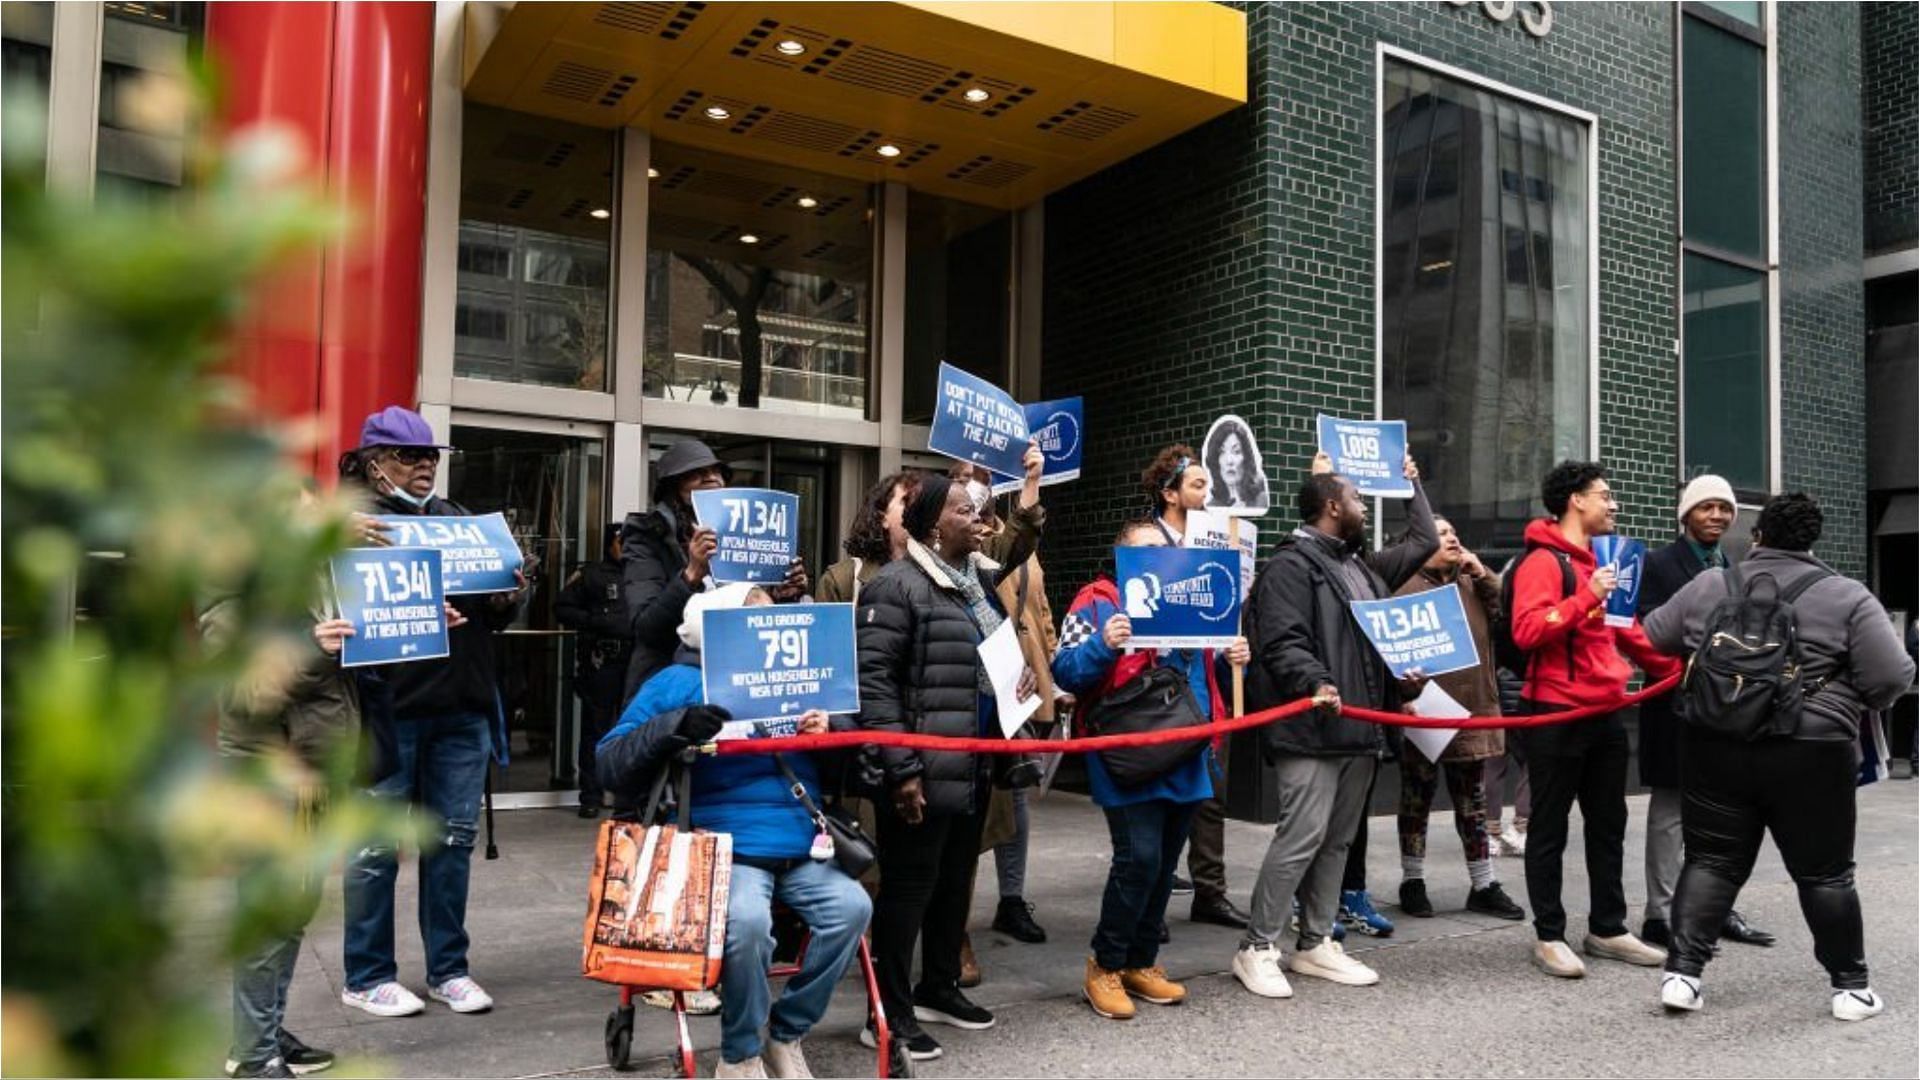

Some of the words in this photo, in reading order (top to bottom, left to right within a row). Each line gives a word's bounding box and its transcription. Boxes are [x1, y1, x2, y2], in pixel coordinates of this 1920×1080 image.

[945, 381, 975, 404] DON'T
[976, 392, 996, 413] PUT
[947, 400, 963, 418] AT
[966, 406, 986, 425] THE
[987, 414, 1013, 436] BACK
[963, 422, 984, 443] THE
[722, 498, 787, 537] 71,341
[387, 521, 488, 546] 71,341
[748, 538, 789, 552] HOUSEHOLDS
[456, 559, 503, 573] EVICTION
[720, 550, 731, 562] AT
[732, 551, 748, 563] RISK
[759, 553, 790, 566] EVICTION
[355, 560, 433, 603] 71,341
[1163, 574, 1211, 593] COMMUNITY
[1164, 592, 1188, 605] VOICES
[1190, 592, 1214, 608] HEARD
[392, 605, 438, 620] HOUSEHOLDS
[747, 615, 773, 629] POLO
[1365, 601, 1441, 640] 71,341
[364, 624, 377, 640] AT
[379, 623, 399, 637] RISK
[411, 620, 440, 635] EVICTION
[758, 628, 808, 669] 791
[1393, 631, 1451, 652] HOUSEHOLDS
[1413, 642, 1456, 660] EVICTION
[768, 668, 819, 683] HOUSEHOLDS
[820, 667, 834, 680] AT
[749, 685, 771, 698] RISK
[773, 684, 785, 697] OF
[787, 681, 820, 695] EVICTION
